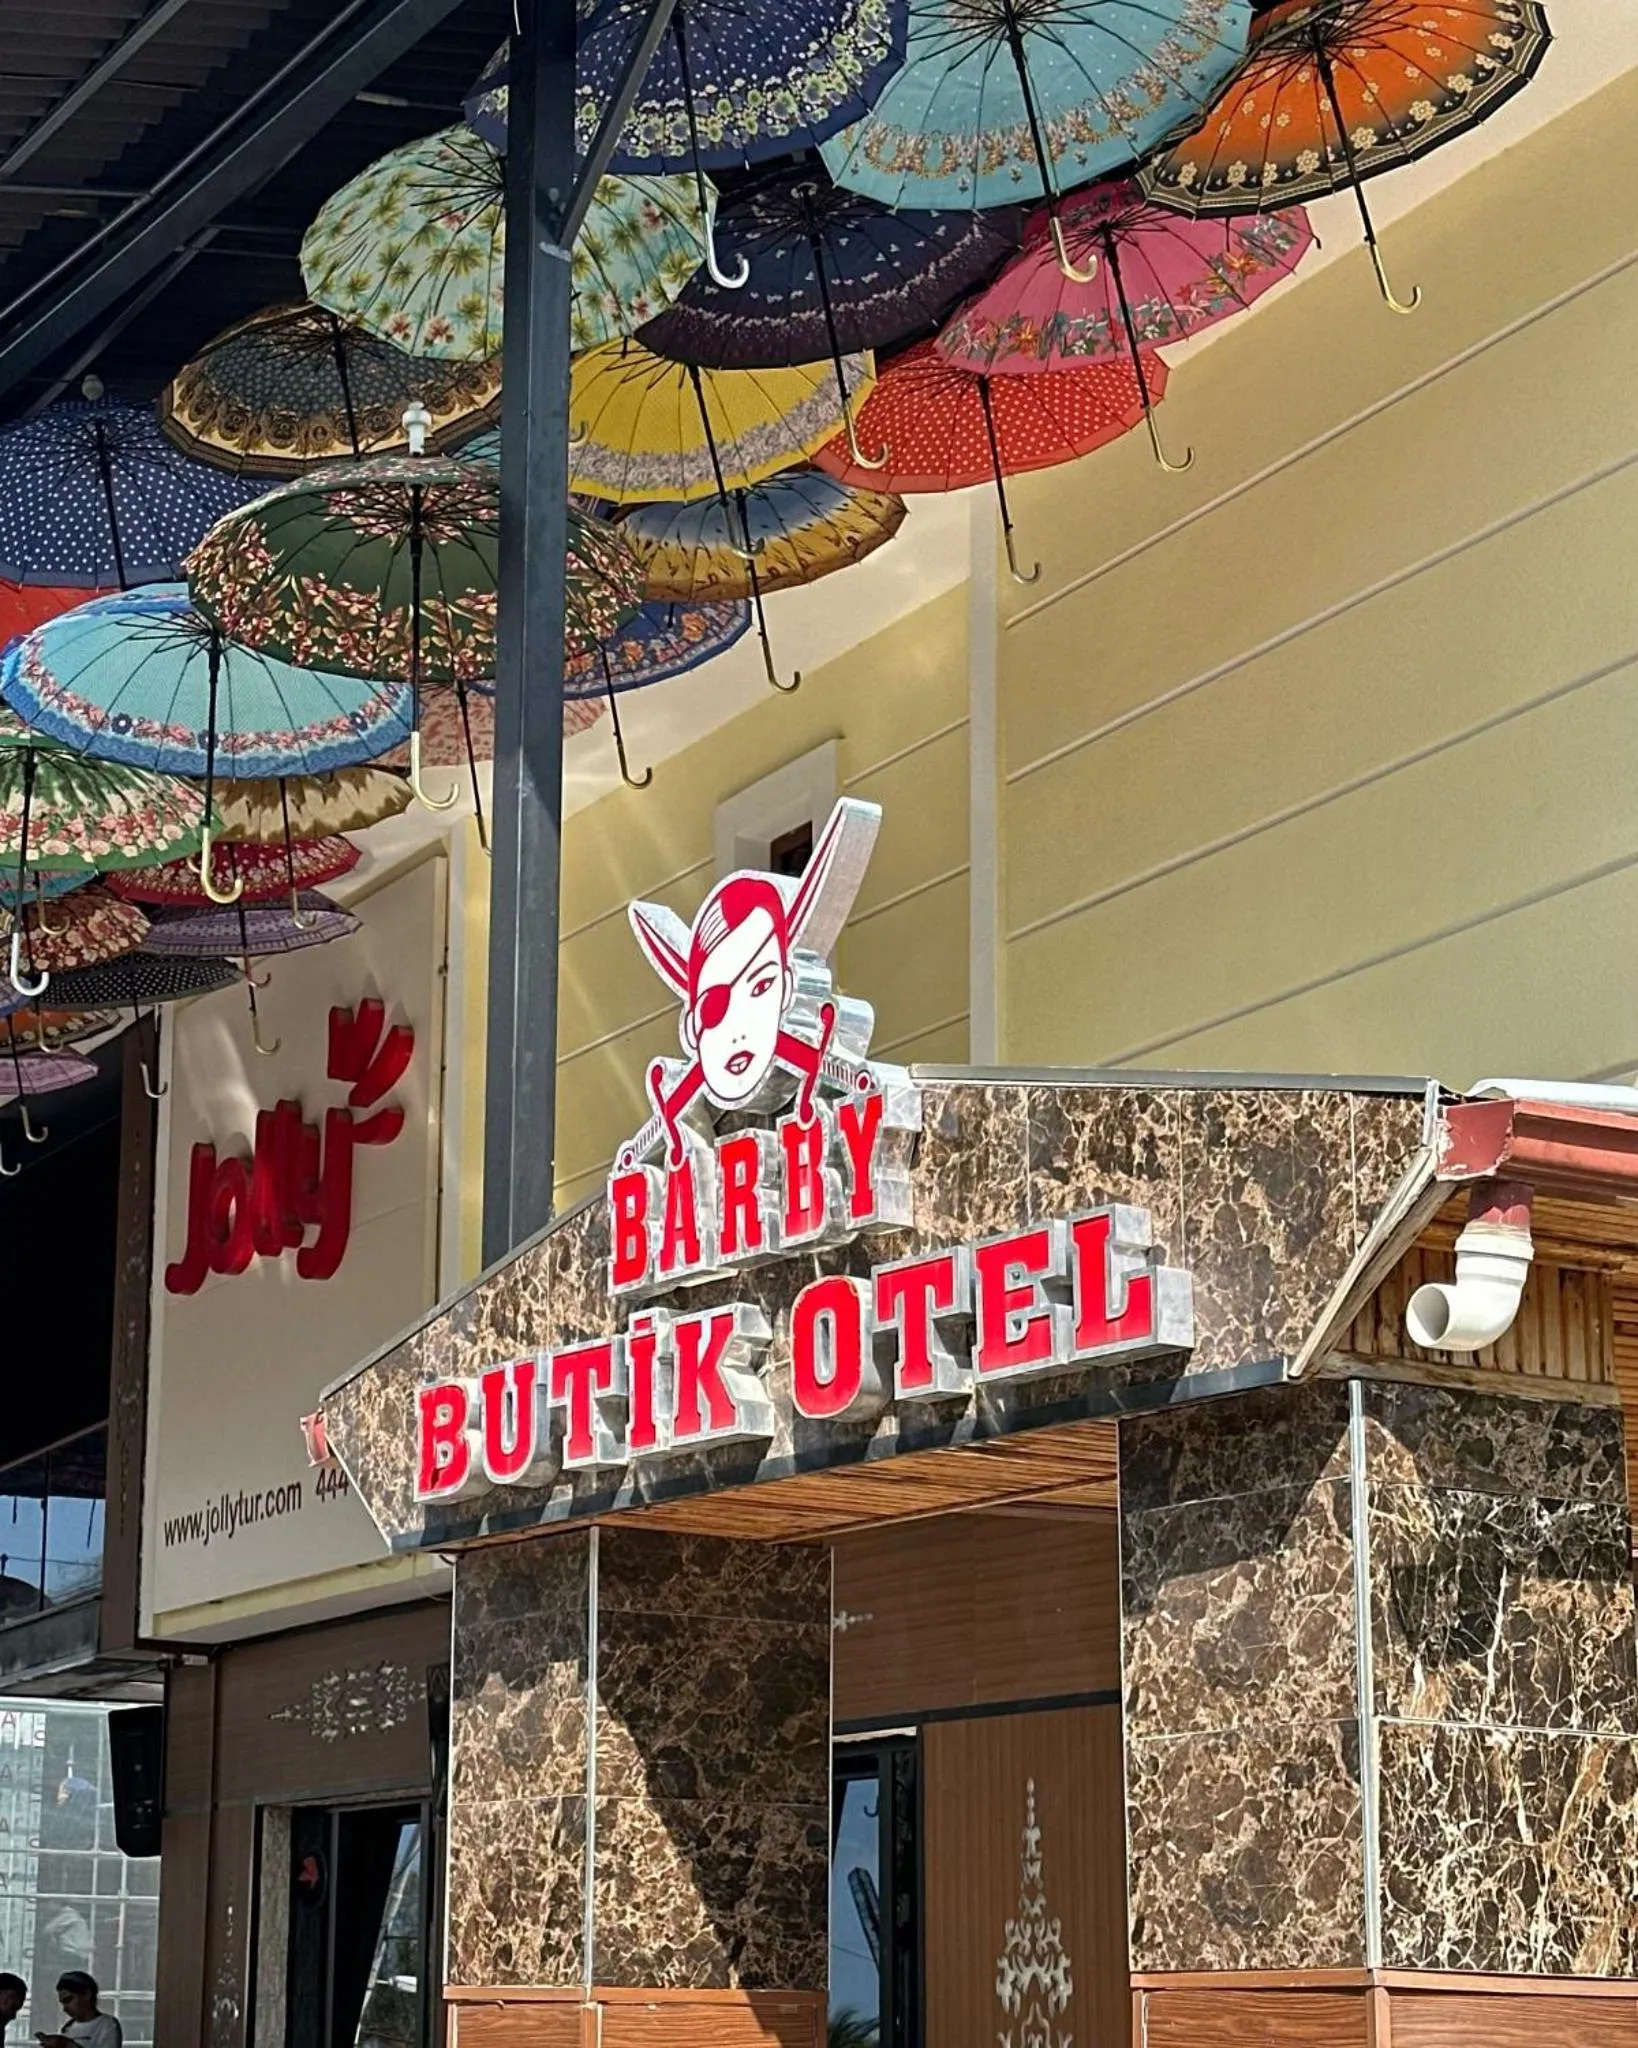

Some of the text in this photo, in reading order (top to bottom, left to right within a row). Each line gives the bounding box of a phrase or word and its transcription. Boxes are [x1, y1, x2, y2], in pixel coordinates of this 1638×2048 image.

[606, 1090, 888, 1298] BARBY
[413, 1206, 1156, 1503] BUTİK OTEL
[164, 1467, 349, 1547] www.jollytur.com 444
